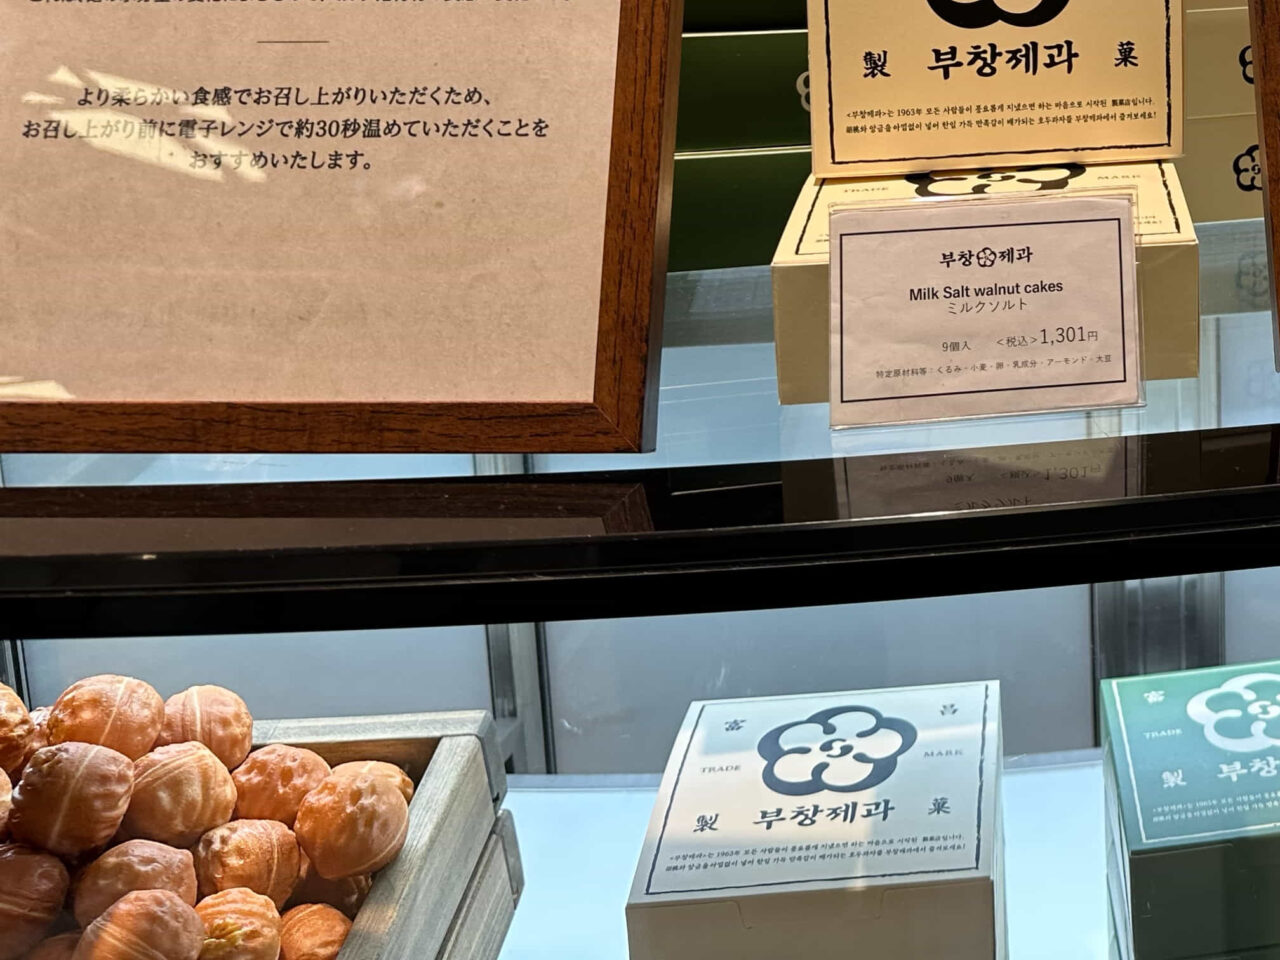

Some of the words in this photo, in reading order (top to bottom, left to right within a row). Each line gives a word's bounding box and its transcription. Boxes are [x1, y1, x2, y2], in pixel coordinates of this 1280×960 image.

[862, 50, 891, 80] 製
[927, 40, 1080, 81] 부창제과
[1113, 41, 1139, 69] 菓
[76, 86, 491, 108] より柔らかい食感でお召し上がりいただくため、
[189, 149, 374, 171] おすすめいたします。
[908, 285, 939, 302] Milk
[943, 283, 970, 300] Salt
[973, 281, 1022, 297] walnut
[1024, 278, 1064, 295] cakes
[946, 297, 1028, 315] ミルクソルト
[942, 341, 972, 353] 9個入
[1144, 728, 1183, 739] TRADE
[700, 764, 741, 774] TRADE
[923, 749, 964, 758] MARK
[753, 798, 895, 830] 부창제과
